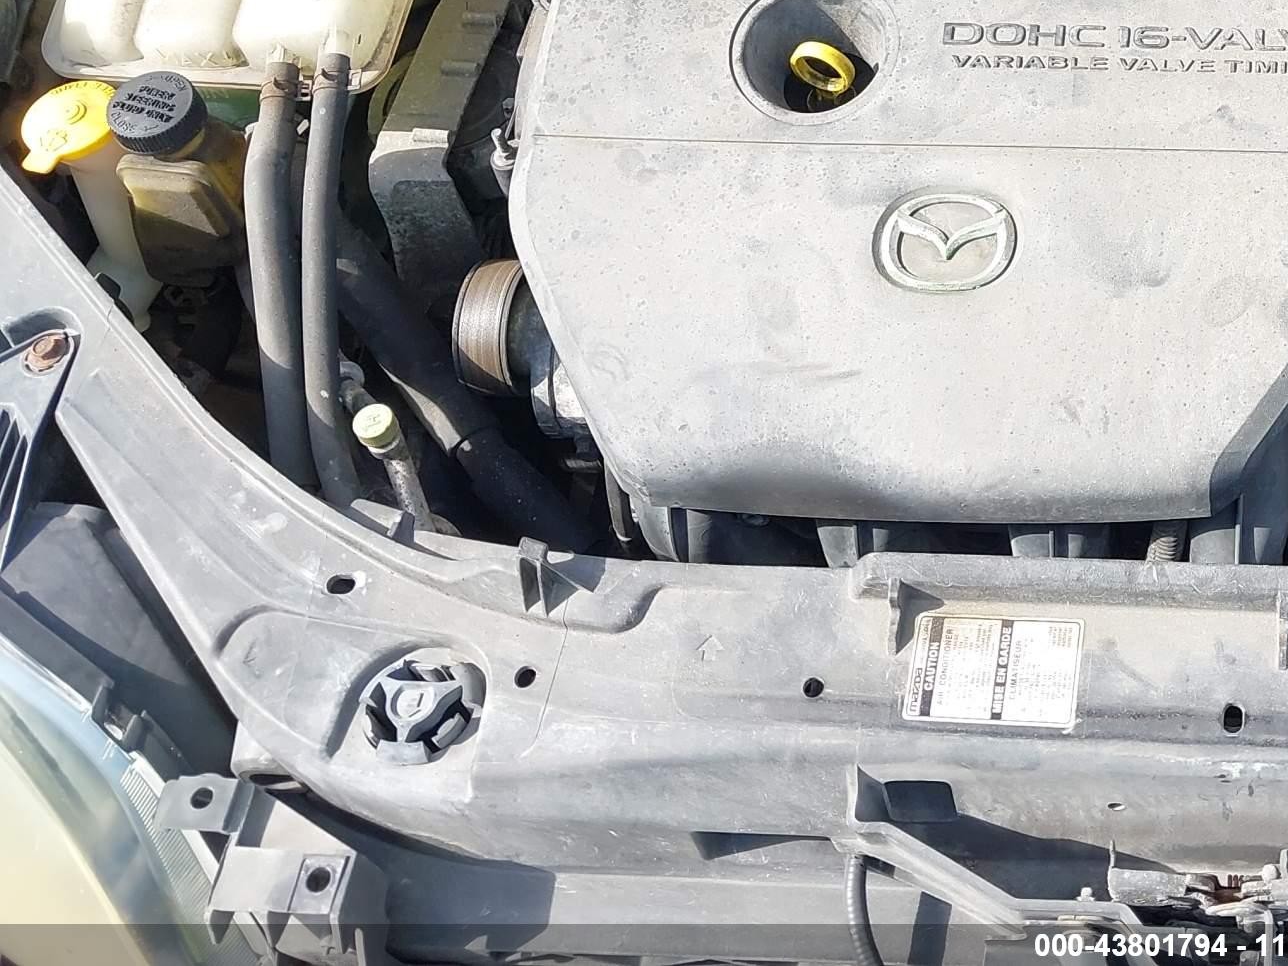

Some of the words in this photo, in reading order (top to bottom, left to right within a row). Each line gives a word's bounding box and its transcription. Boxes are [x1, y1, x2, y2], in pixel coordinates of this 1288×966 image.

[942, 22, 1107, 48] DOHC
[951, 54, 1109, 71] VARIABLE
[1119, 57, 1216, 74] VALVE
[939, 628, 954, 686] CONDITIONER
[998, 627, 1012, 666] GARDE
[923, 641, 940, 691] CAUTION
[995, 667, 1008, 684] EN
[1008, 640, 1022, 700] CLIMATISEUR
[991, 684, 1005, 713] MISE
